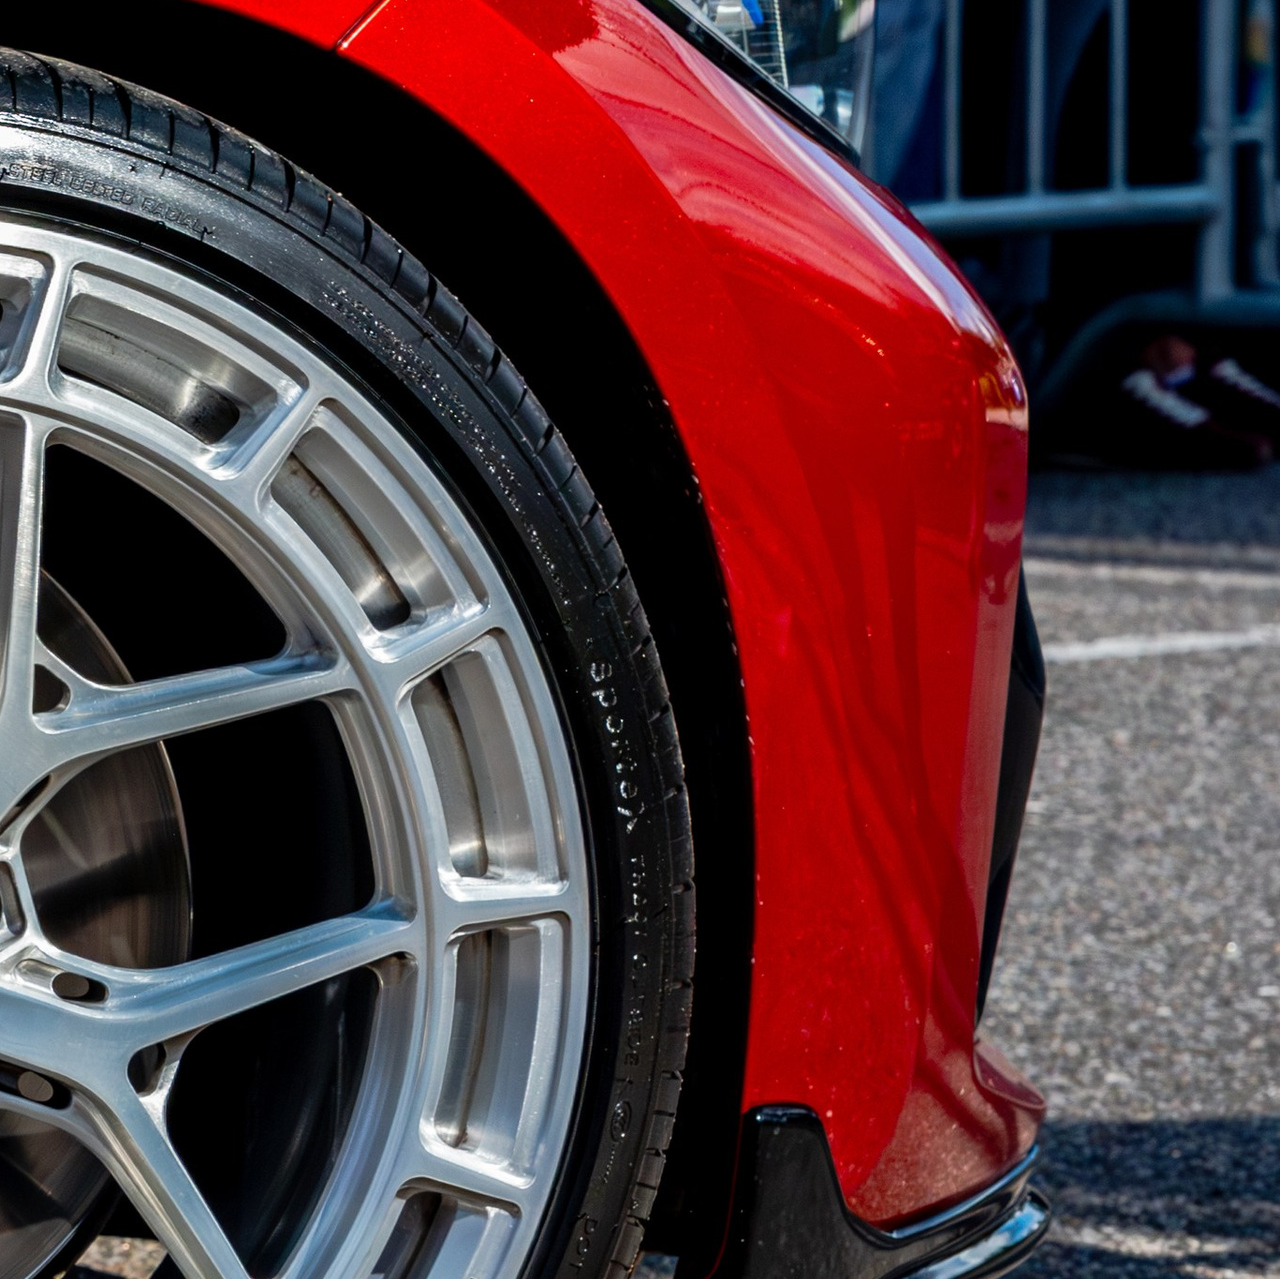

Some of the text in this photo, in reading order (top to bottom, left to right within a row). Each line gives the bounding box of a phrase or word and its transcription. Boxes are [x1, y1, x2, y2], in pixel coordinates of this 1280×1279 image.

[8, 162, 65, 185] STEEL
[69, 178, 134, 204] BELTED
[141, 199, 205, 233] RADIAL
